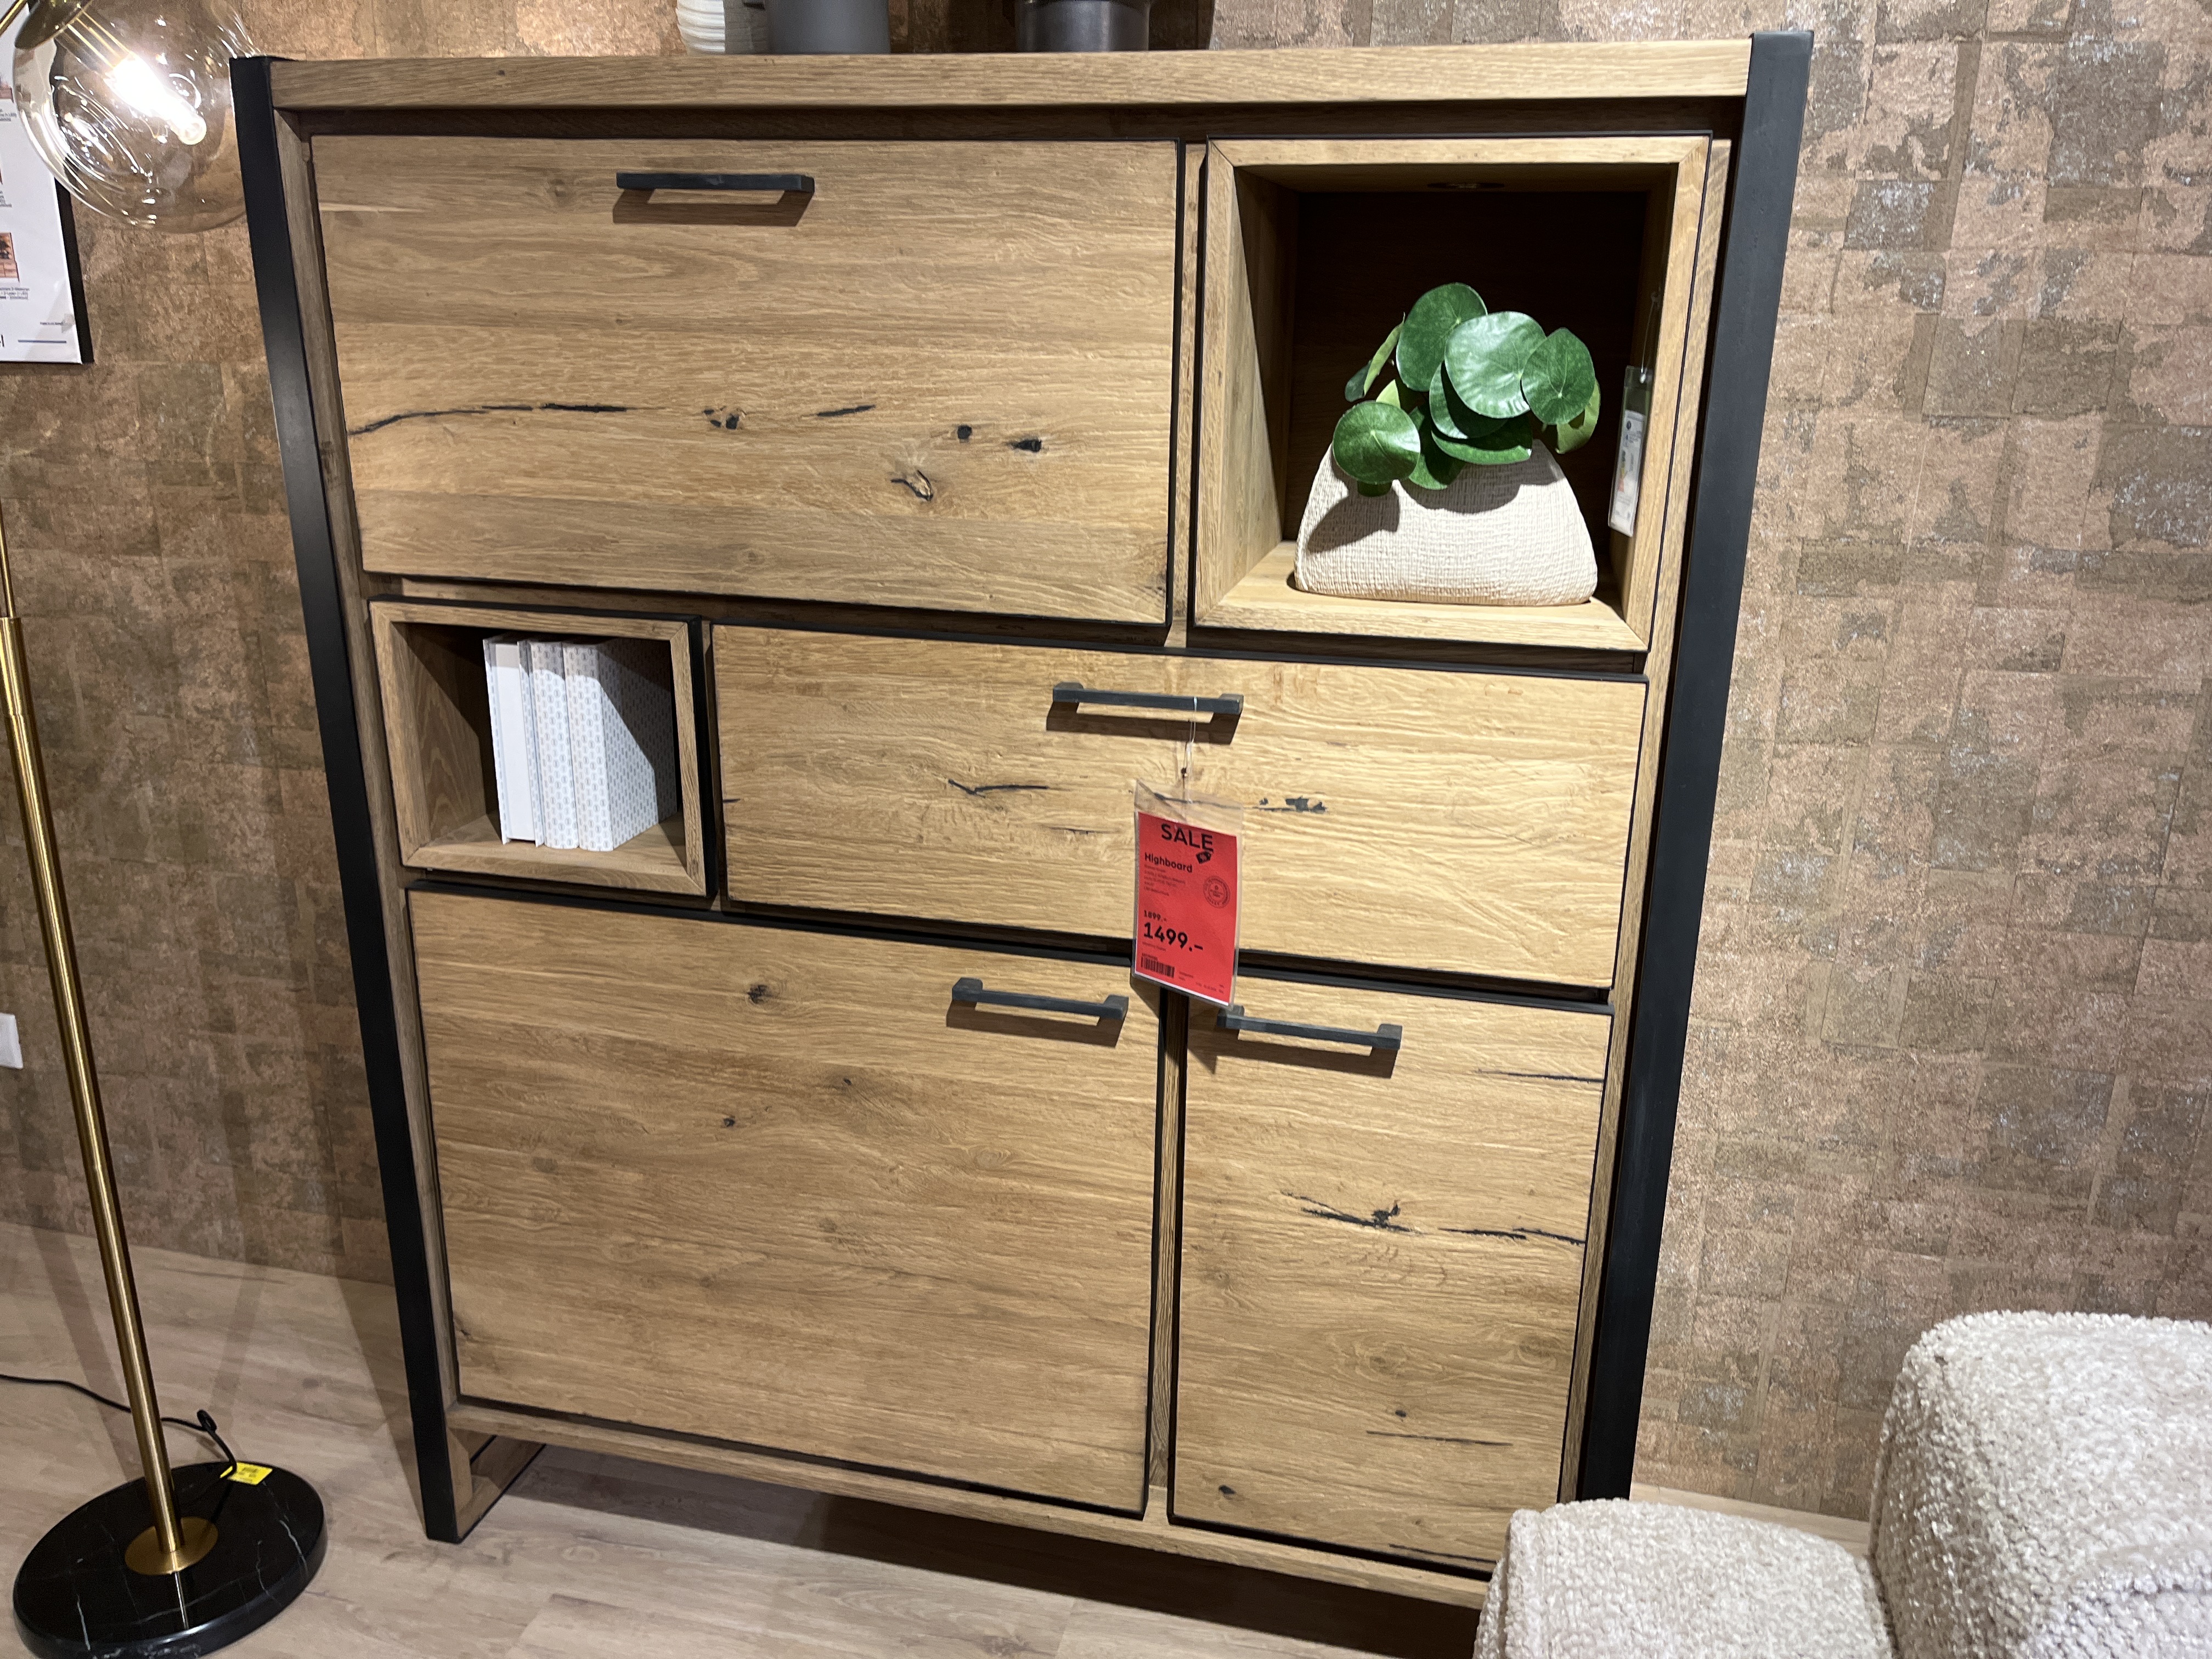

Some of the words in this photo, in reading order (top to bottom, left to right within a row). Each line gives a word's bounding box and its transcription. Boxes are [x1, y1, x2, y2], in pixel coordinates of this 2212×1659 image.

[1161, 823, 1214, 853] SALE
[1144, 852, 1193, 873] Highboard
[1144, 922, 1203, 951] 1499.-
